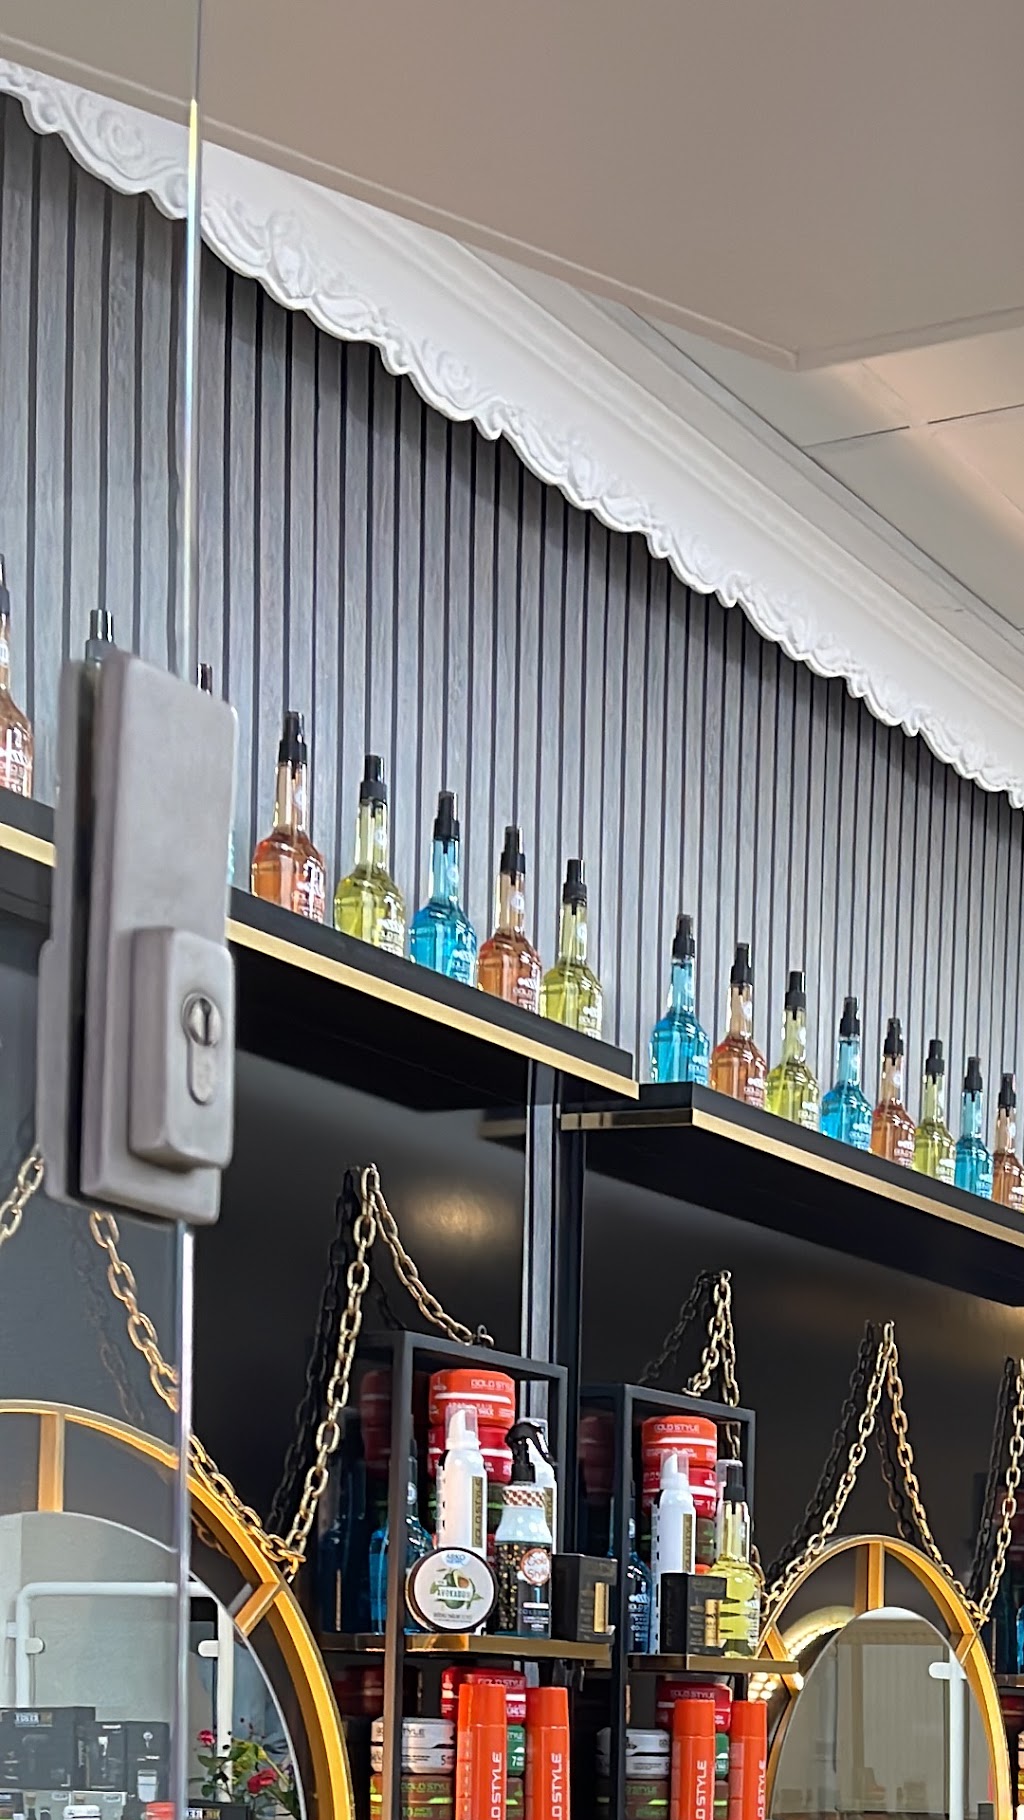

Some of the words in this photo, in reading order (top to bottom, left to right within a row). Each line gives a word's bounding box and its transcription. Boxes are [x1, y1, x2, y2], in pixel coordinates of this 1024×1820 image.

[471, 1379, 495, 1388] GOLD
[677, 1424, 700, 1432] STYLE
[402, 1727, 425, 1736] TYLE
[491, 1752, 503, 1803] STYLE
[551, 1753, 562, 1802] STYLE
[696, 1760, 707, 1805] STYLE
[757, 1760, 767, 1805] STYLE
